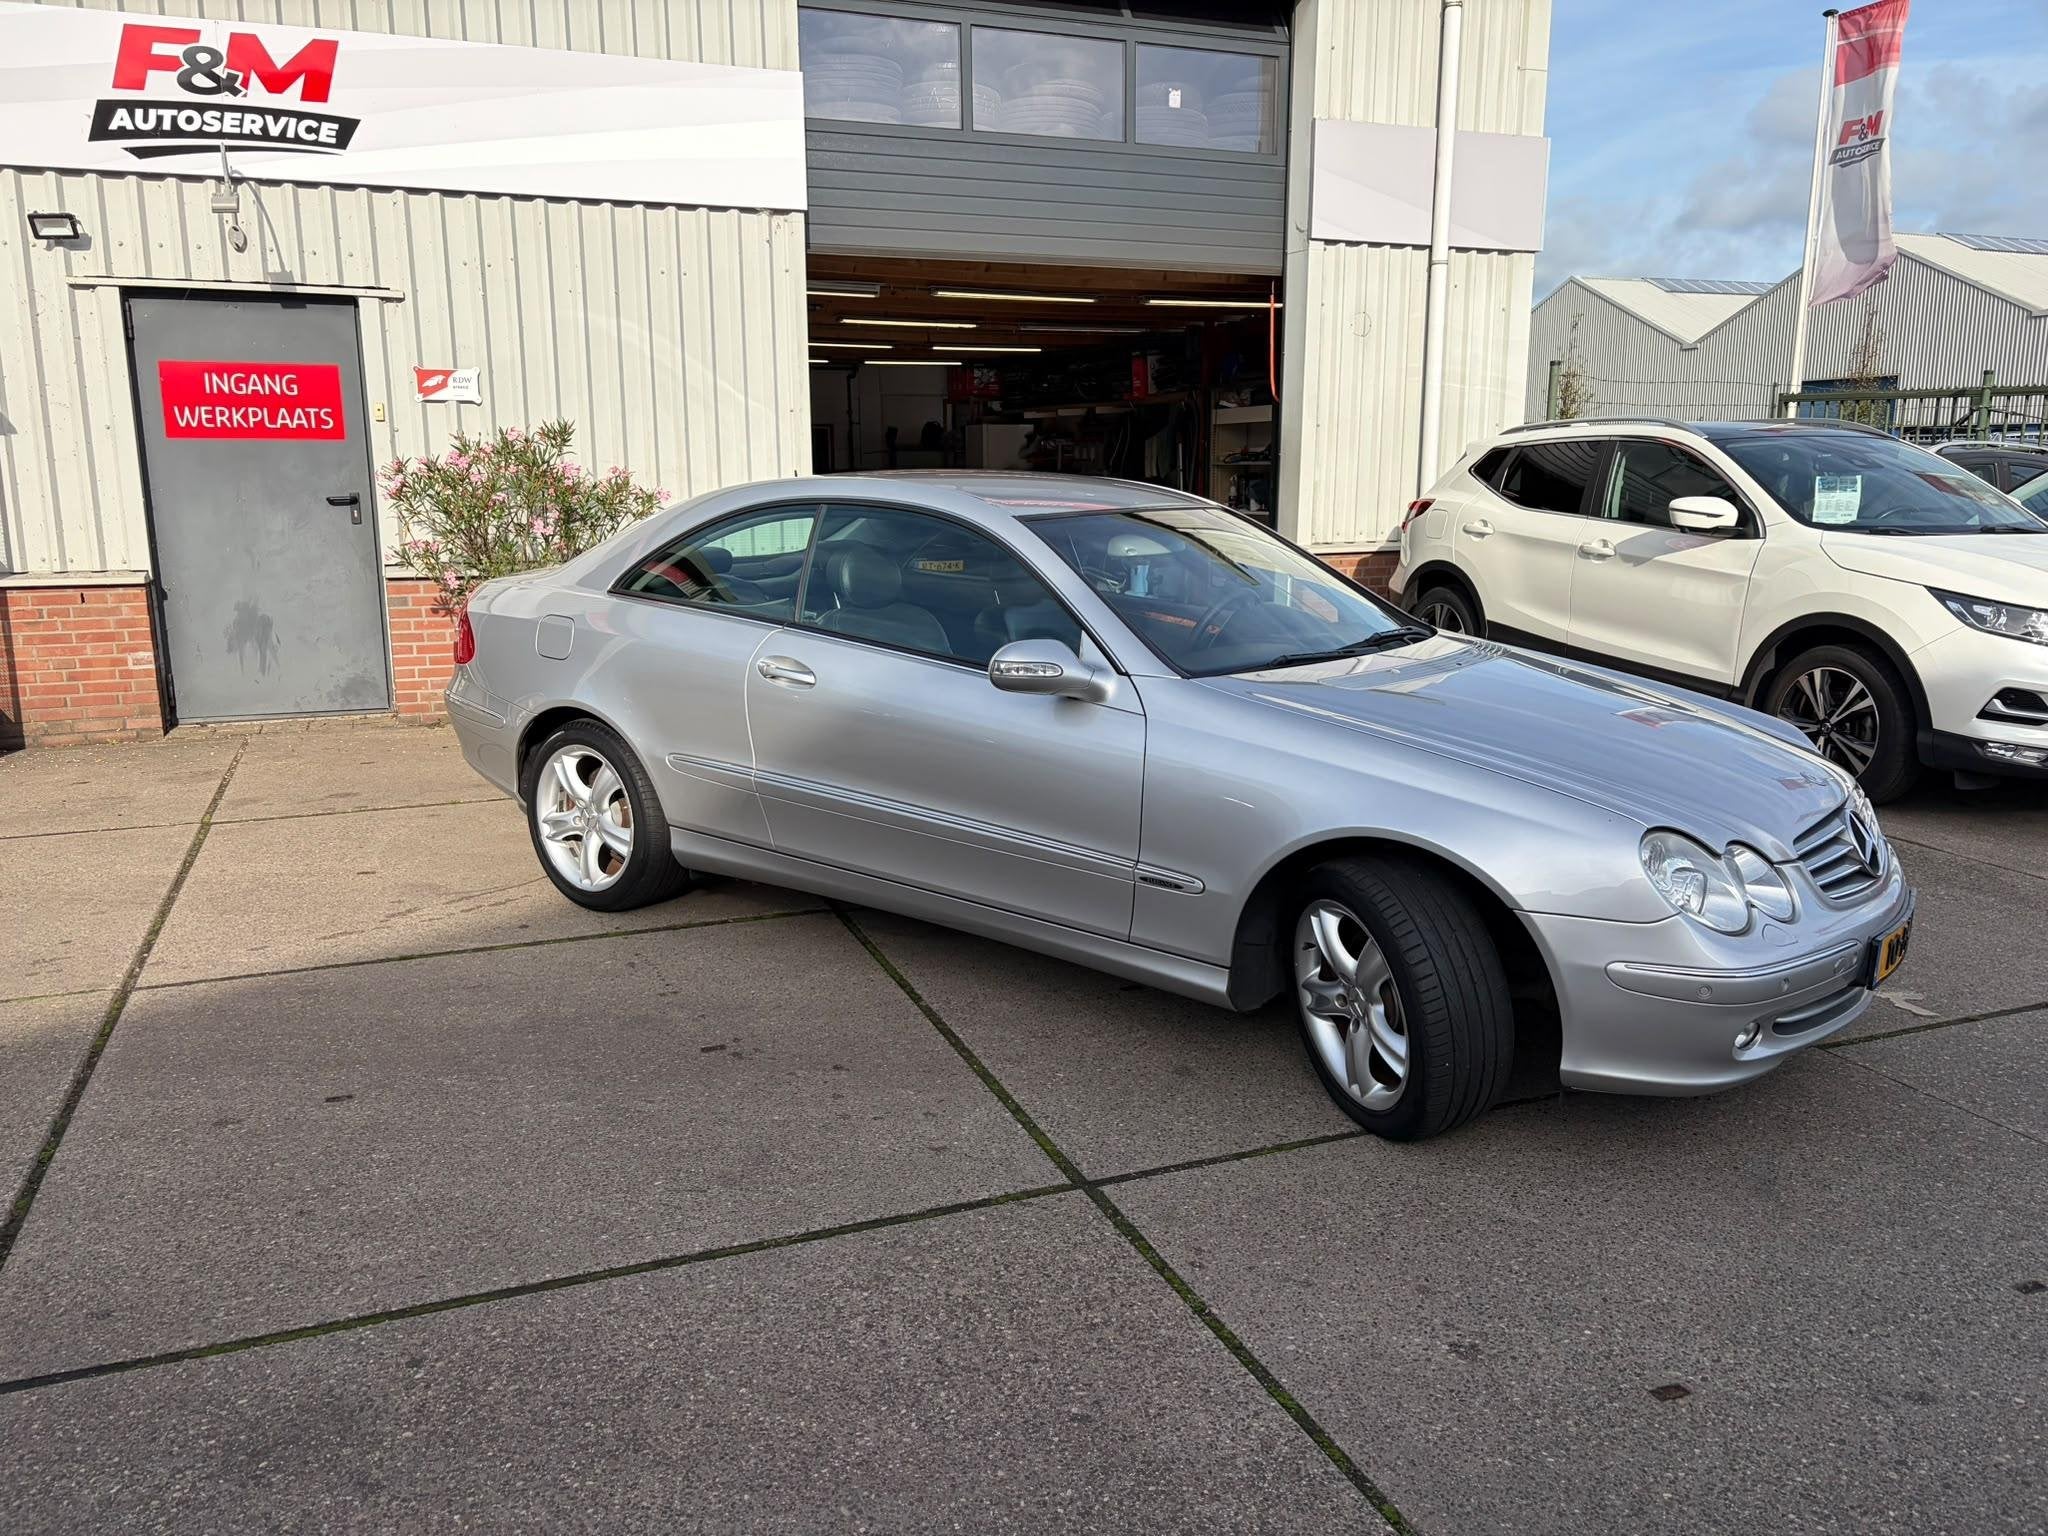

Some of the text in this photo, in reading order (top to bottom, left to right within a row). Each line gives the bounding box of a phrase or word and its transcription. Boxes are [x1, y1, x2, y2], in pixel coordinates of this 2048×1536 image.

[112, 23, 339, 103] F&M
[107, 107, 340, 144] AUTOSERVICE
[1838, 110, 1884, 146] F&M
[203, 372, 299, 396] INGANG
[452, 376, 473, 384] RDW
[173, 405, 335, 430] WERKPLAATS
